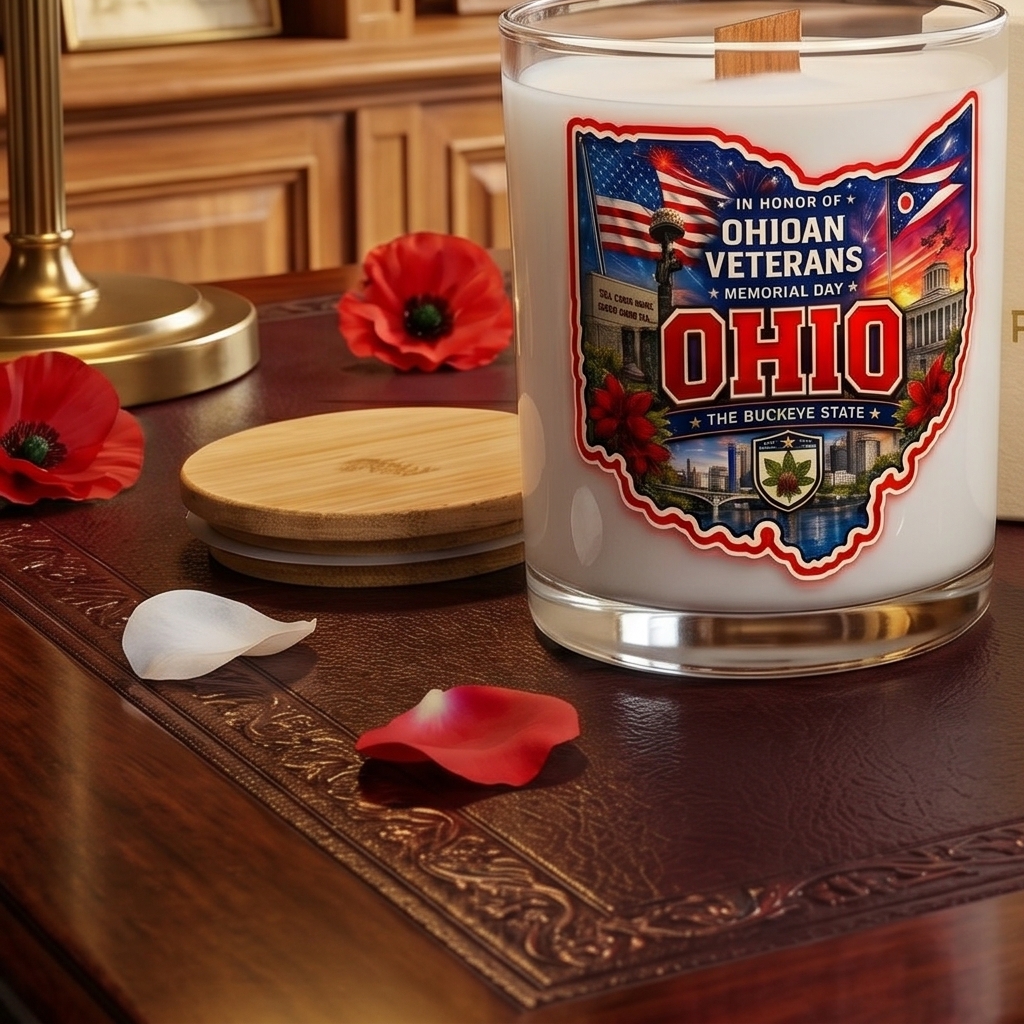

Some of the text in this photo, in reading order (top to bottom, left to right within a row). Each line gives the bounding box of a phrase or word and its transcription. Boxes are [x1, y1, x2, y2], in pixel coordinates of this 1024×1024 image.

[736, 195, 842, 210] IN HONOR OF
[704, 246, 863, 279] VETERANS
[724, 282, 844, 300] MEMORIAL DAY
[660, 298, 904, 405] OHIO
[706, 406, 865, 426] THE BUCKEYE STATE
